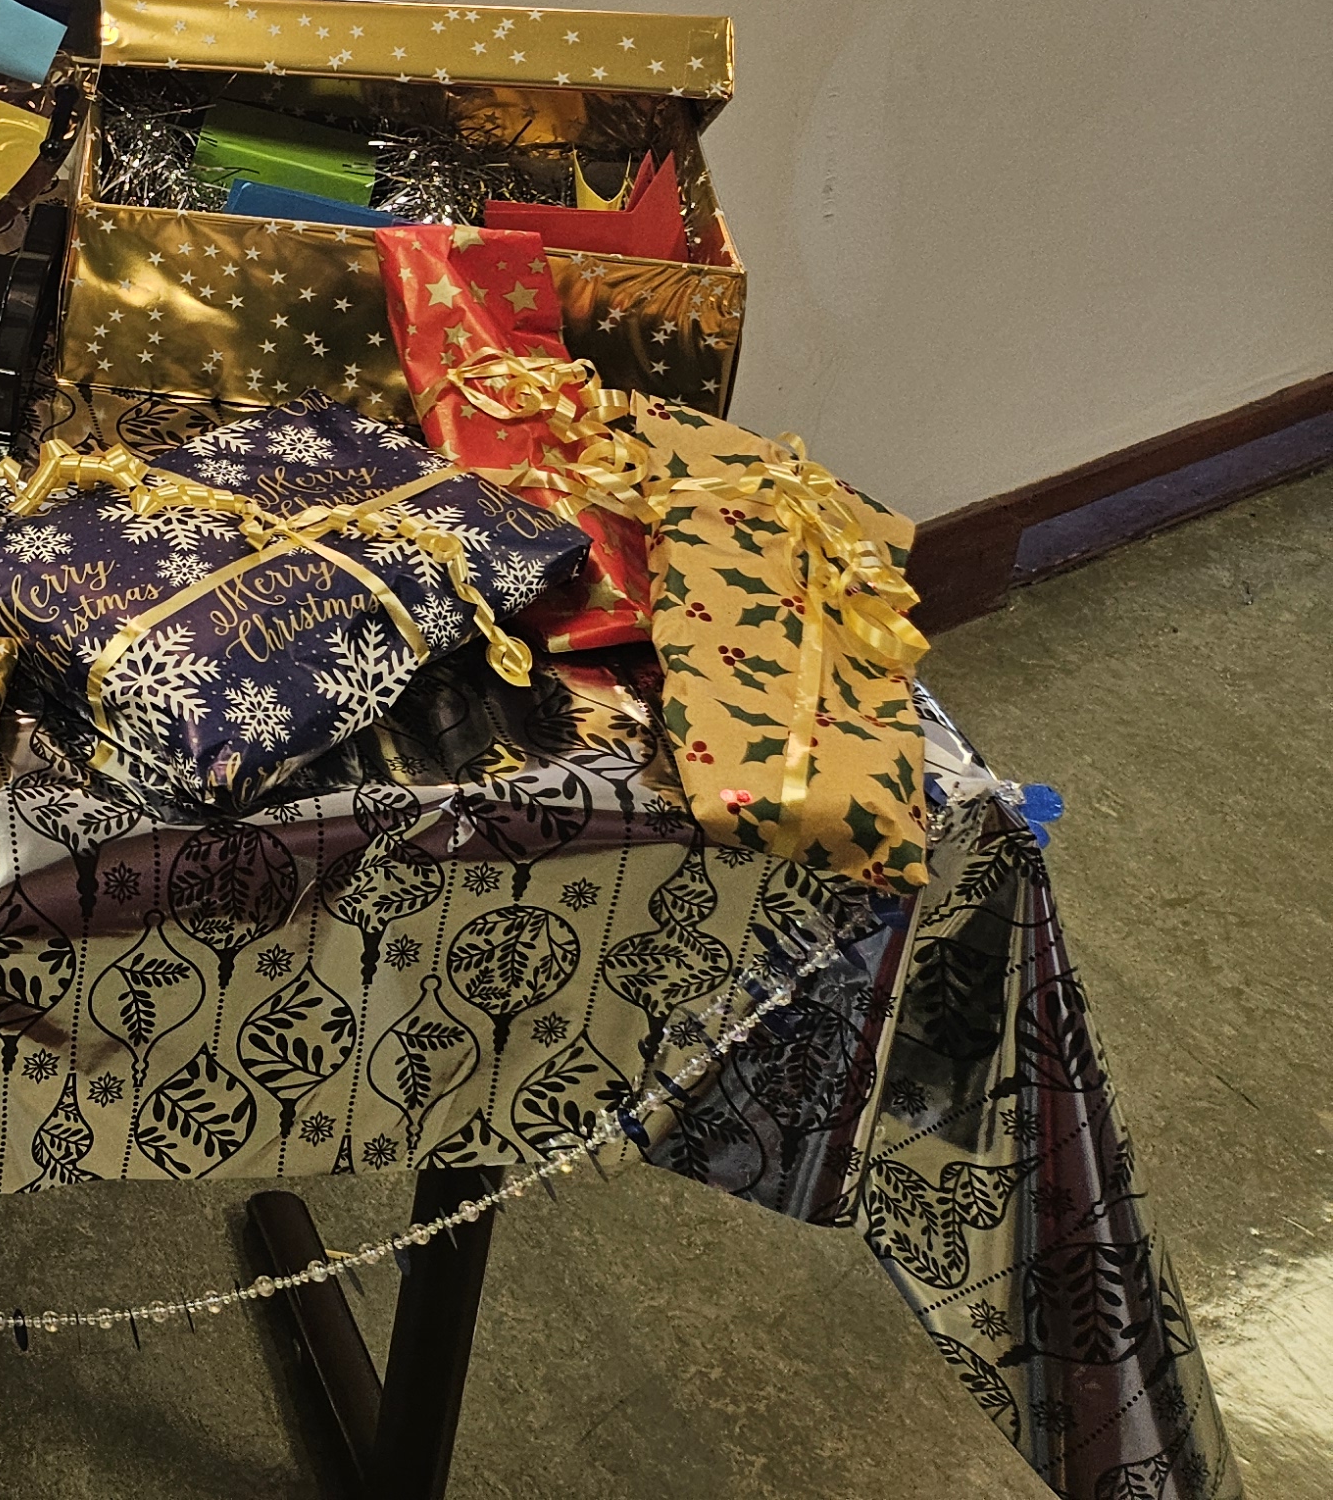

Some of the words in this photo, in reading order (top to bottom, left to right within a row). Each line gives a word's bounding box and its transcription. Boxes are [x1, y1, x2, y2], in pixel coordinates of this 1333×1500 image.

[251, 465, 378, 511] Merry
[209, 561, 337, 637] Merry
[225, 591, 381, 664] Christmas
